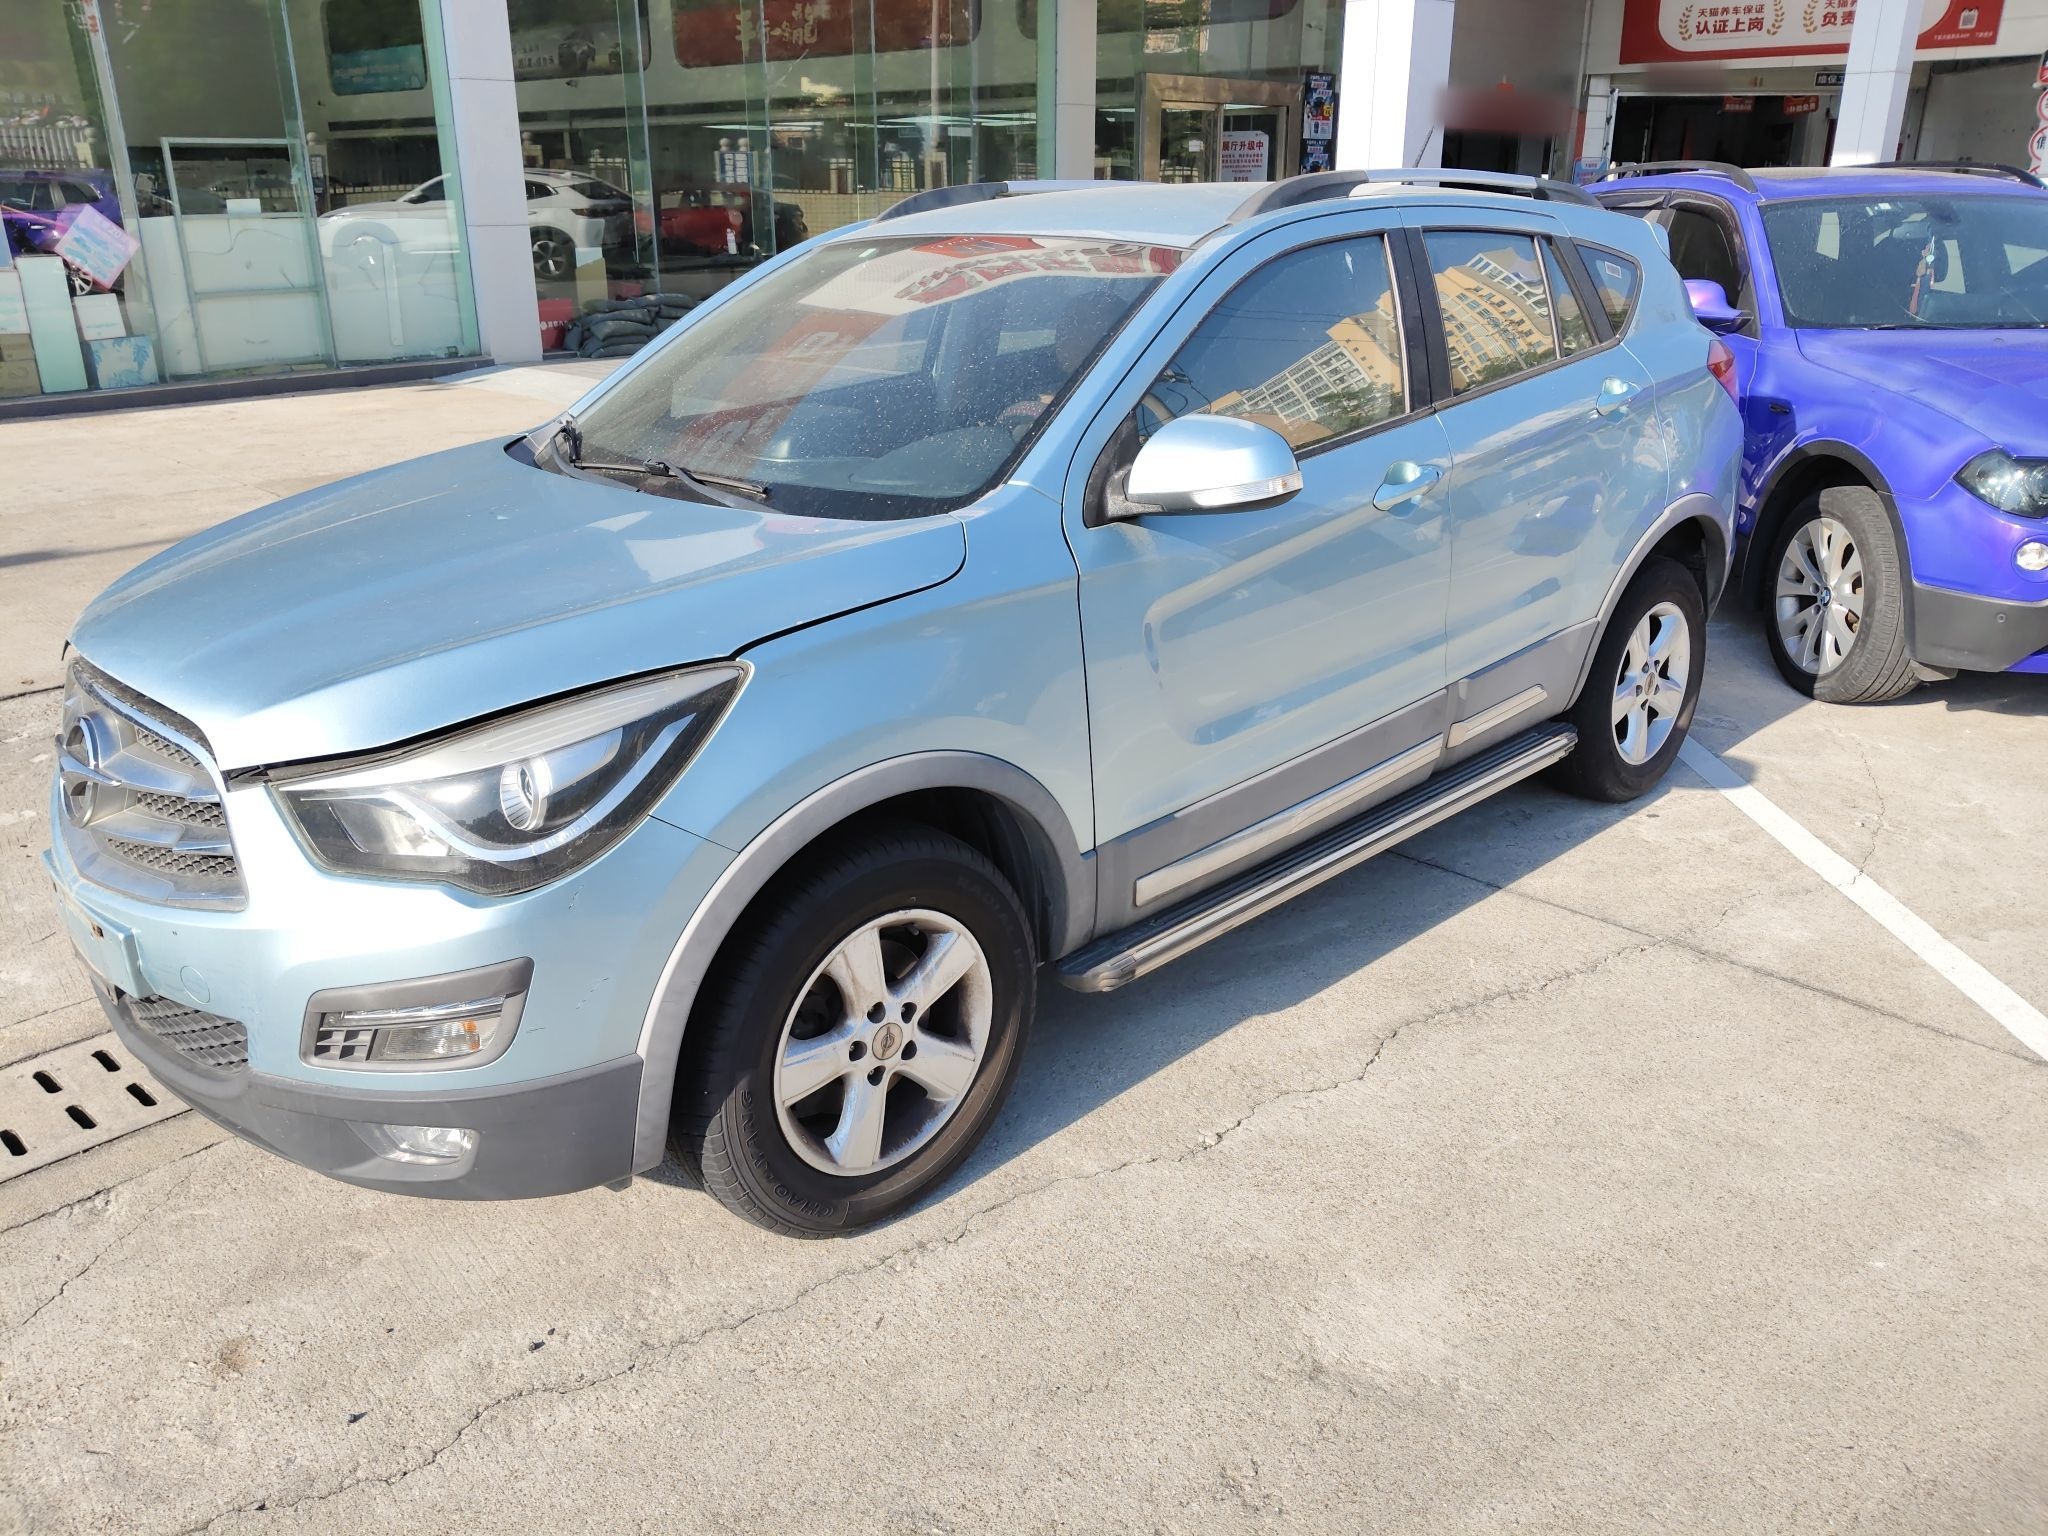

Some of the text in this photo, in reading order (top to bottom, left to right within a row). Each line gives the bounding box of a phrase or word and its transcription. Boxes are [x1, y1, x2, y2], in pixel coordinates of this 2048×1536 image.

[1698, 4, 1765, 17] 天猫养车保证
[1696, 17, 1764, 35] 认证上岗
[1222, 140, 1264, 151] 展厅升级中
